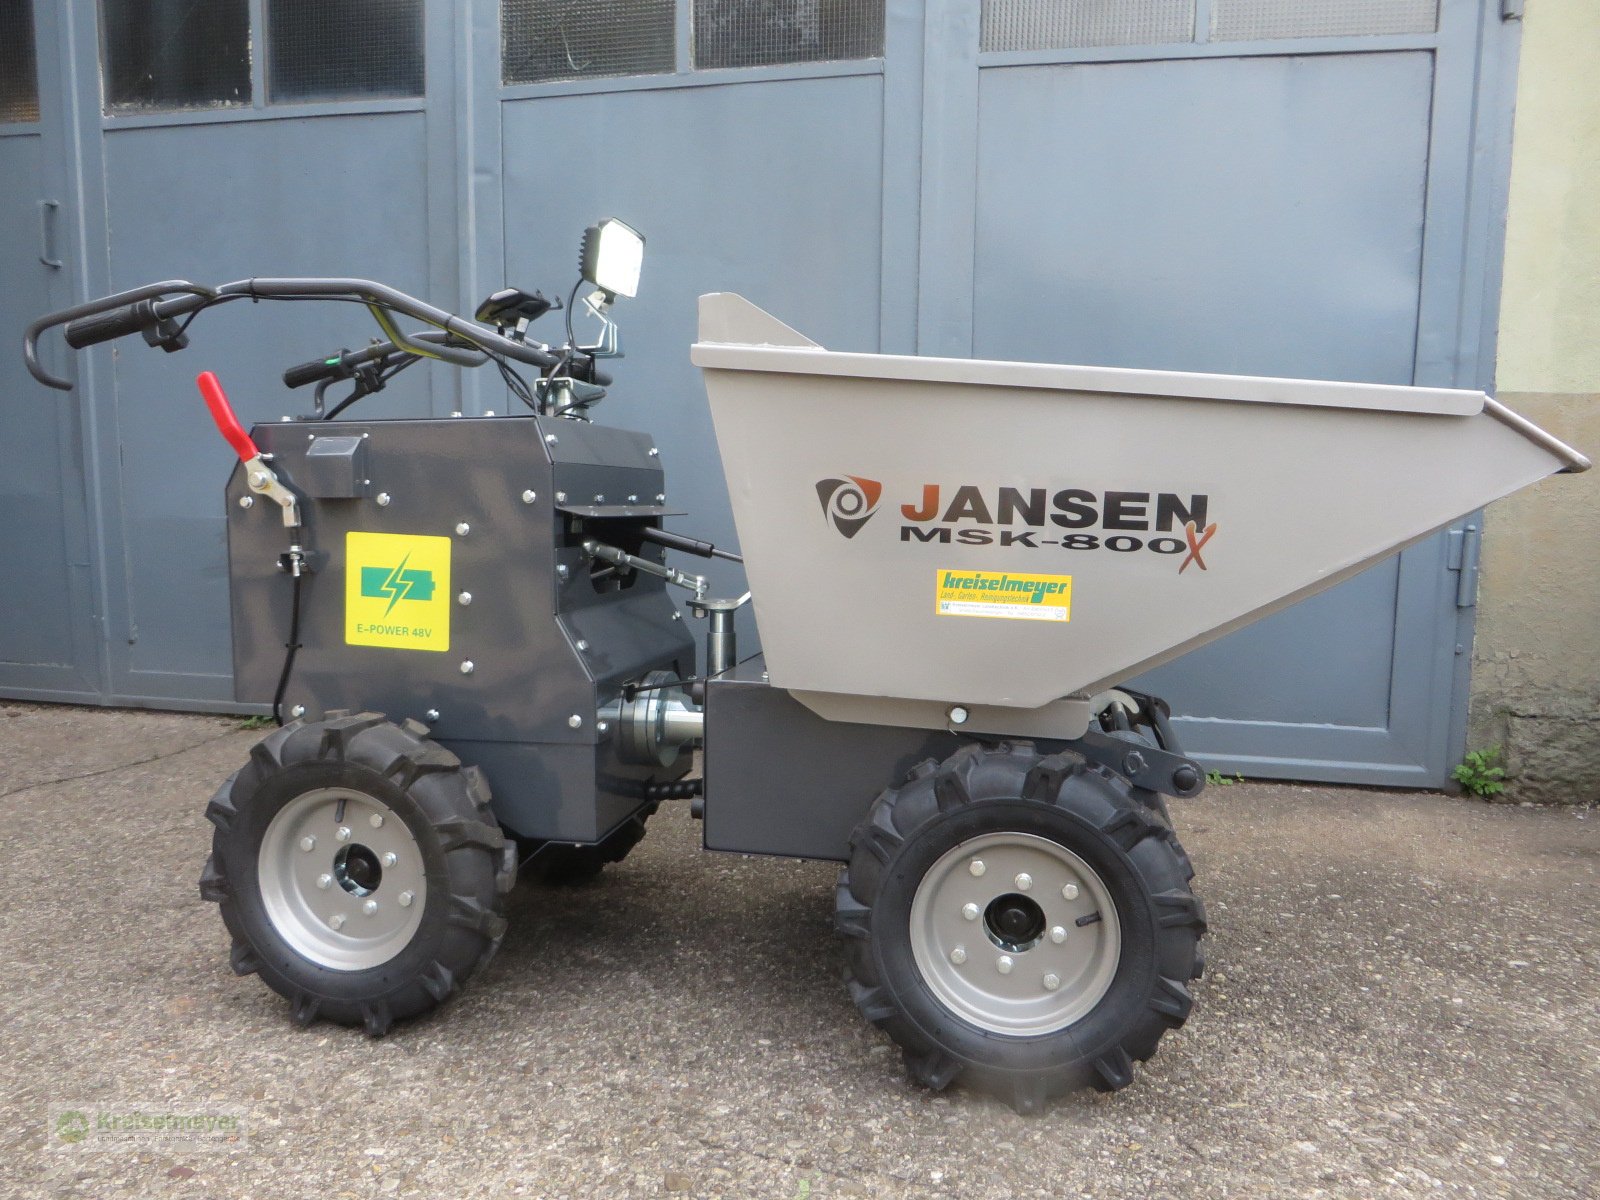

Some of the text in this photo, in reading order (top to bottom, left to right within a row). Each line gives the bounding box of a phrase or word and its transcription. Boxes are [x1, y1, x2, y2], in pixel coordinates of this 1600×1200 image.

[900, 484, 1208, 534] JANSEN
[943, 572, 1068, 604] kreiselmeyer
[357, 623, 432, 638] E-POWER 48V
